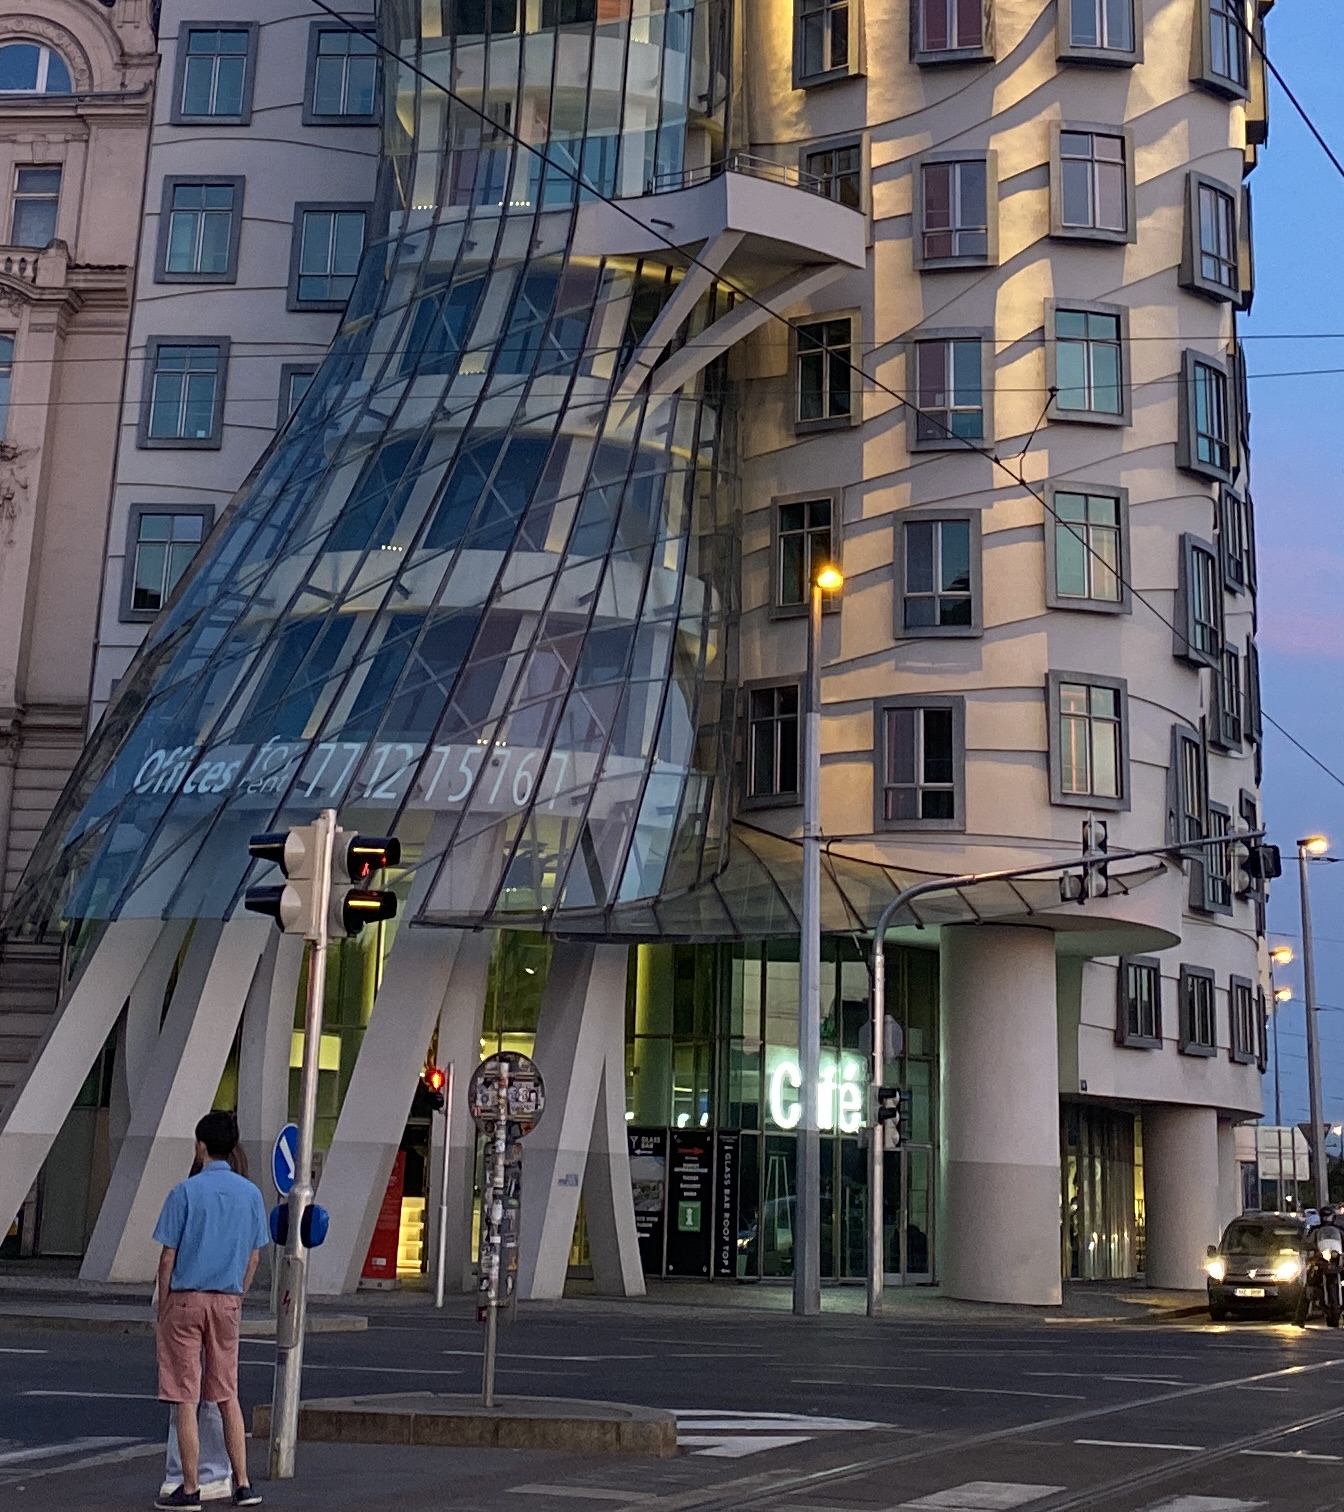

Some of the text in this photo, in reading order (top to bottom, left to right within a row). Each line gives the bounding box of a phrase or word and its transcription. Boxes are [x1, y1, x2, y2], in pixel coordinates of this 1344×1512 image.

[134, 745, 240, 794] Offices
[770, 1061, 862, 1133] Cfé
[723, 1152, 731, 1185] GLASS
[723, 1189, 731, 1209] BAR
[721, 1245, 729, 1266] TOP
